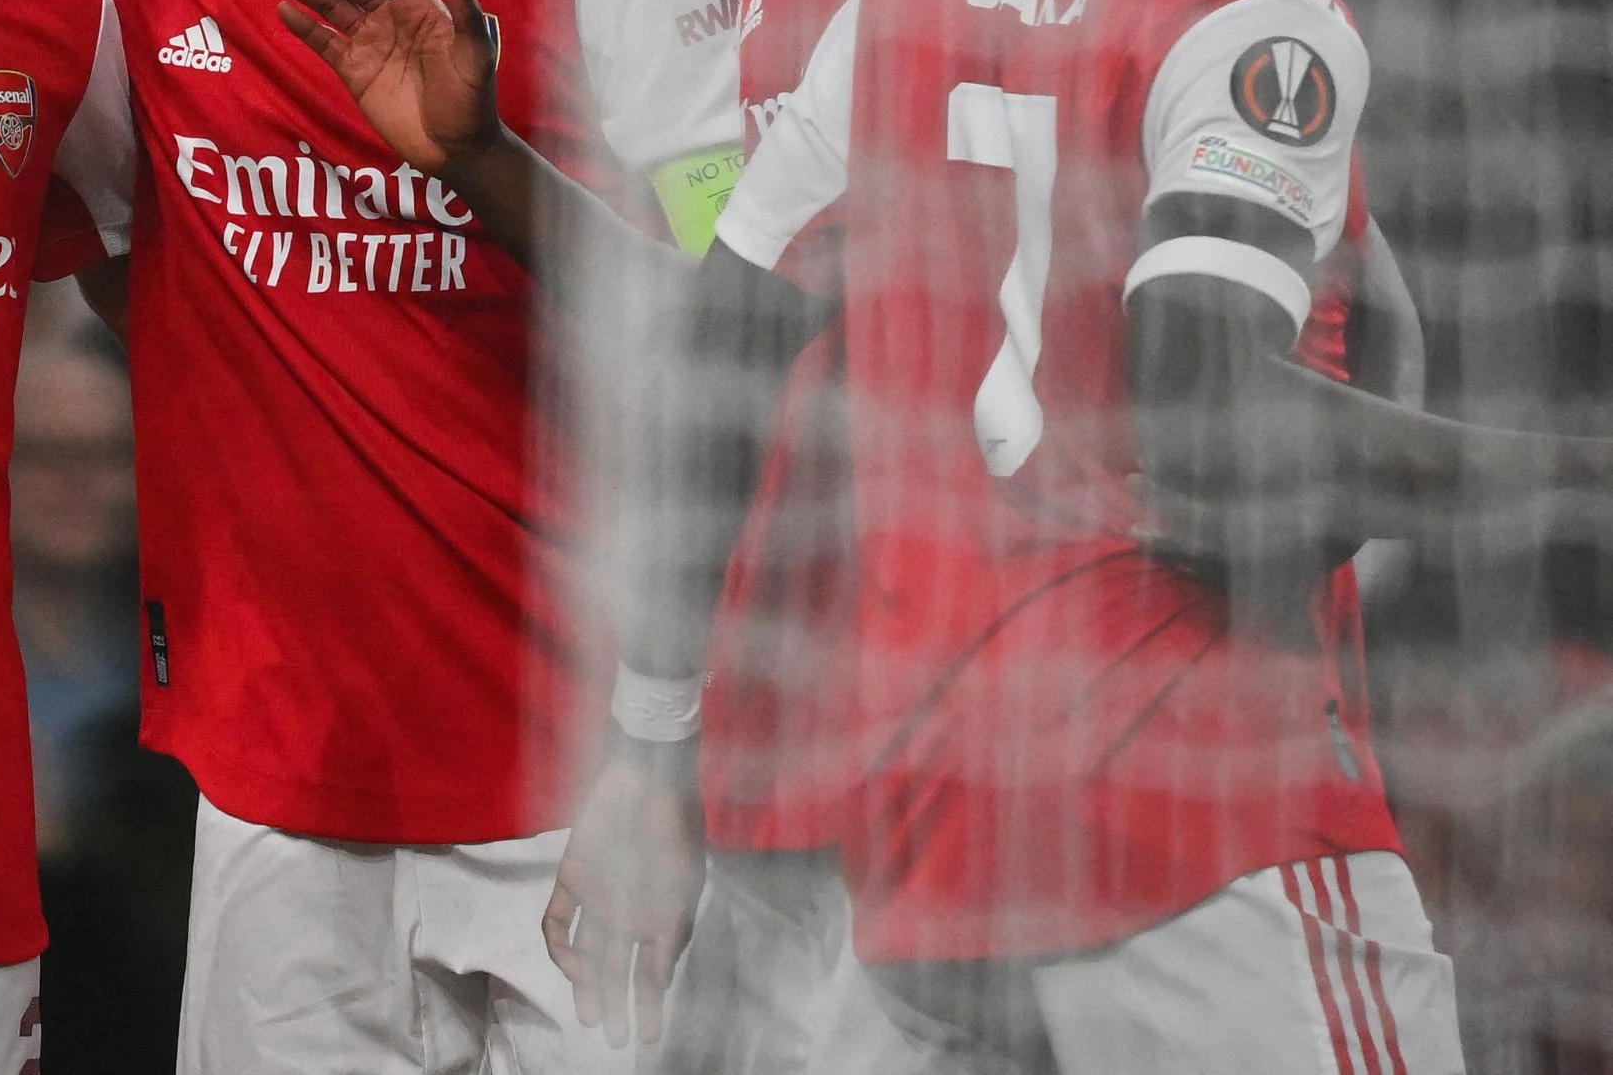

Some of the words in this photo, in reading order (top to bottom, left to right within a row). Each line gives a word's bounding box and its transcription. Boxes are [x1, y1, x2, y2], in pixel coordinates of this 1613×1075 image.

[158, 45, 232, 73] adidas
[173, 132, 473, 226] Emirate
[686, 162, 720, 187] NO
[223, 222, 293, 287] FLY
[306, 232, 466, 293] BETTER
[947, 82, 1057, 476] 7
